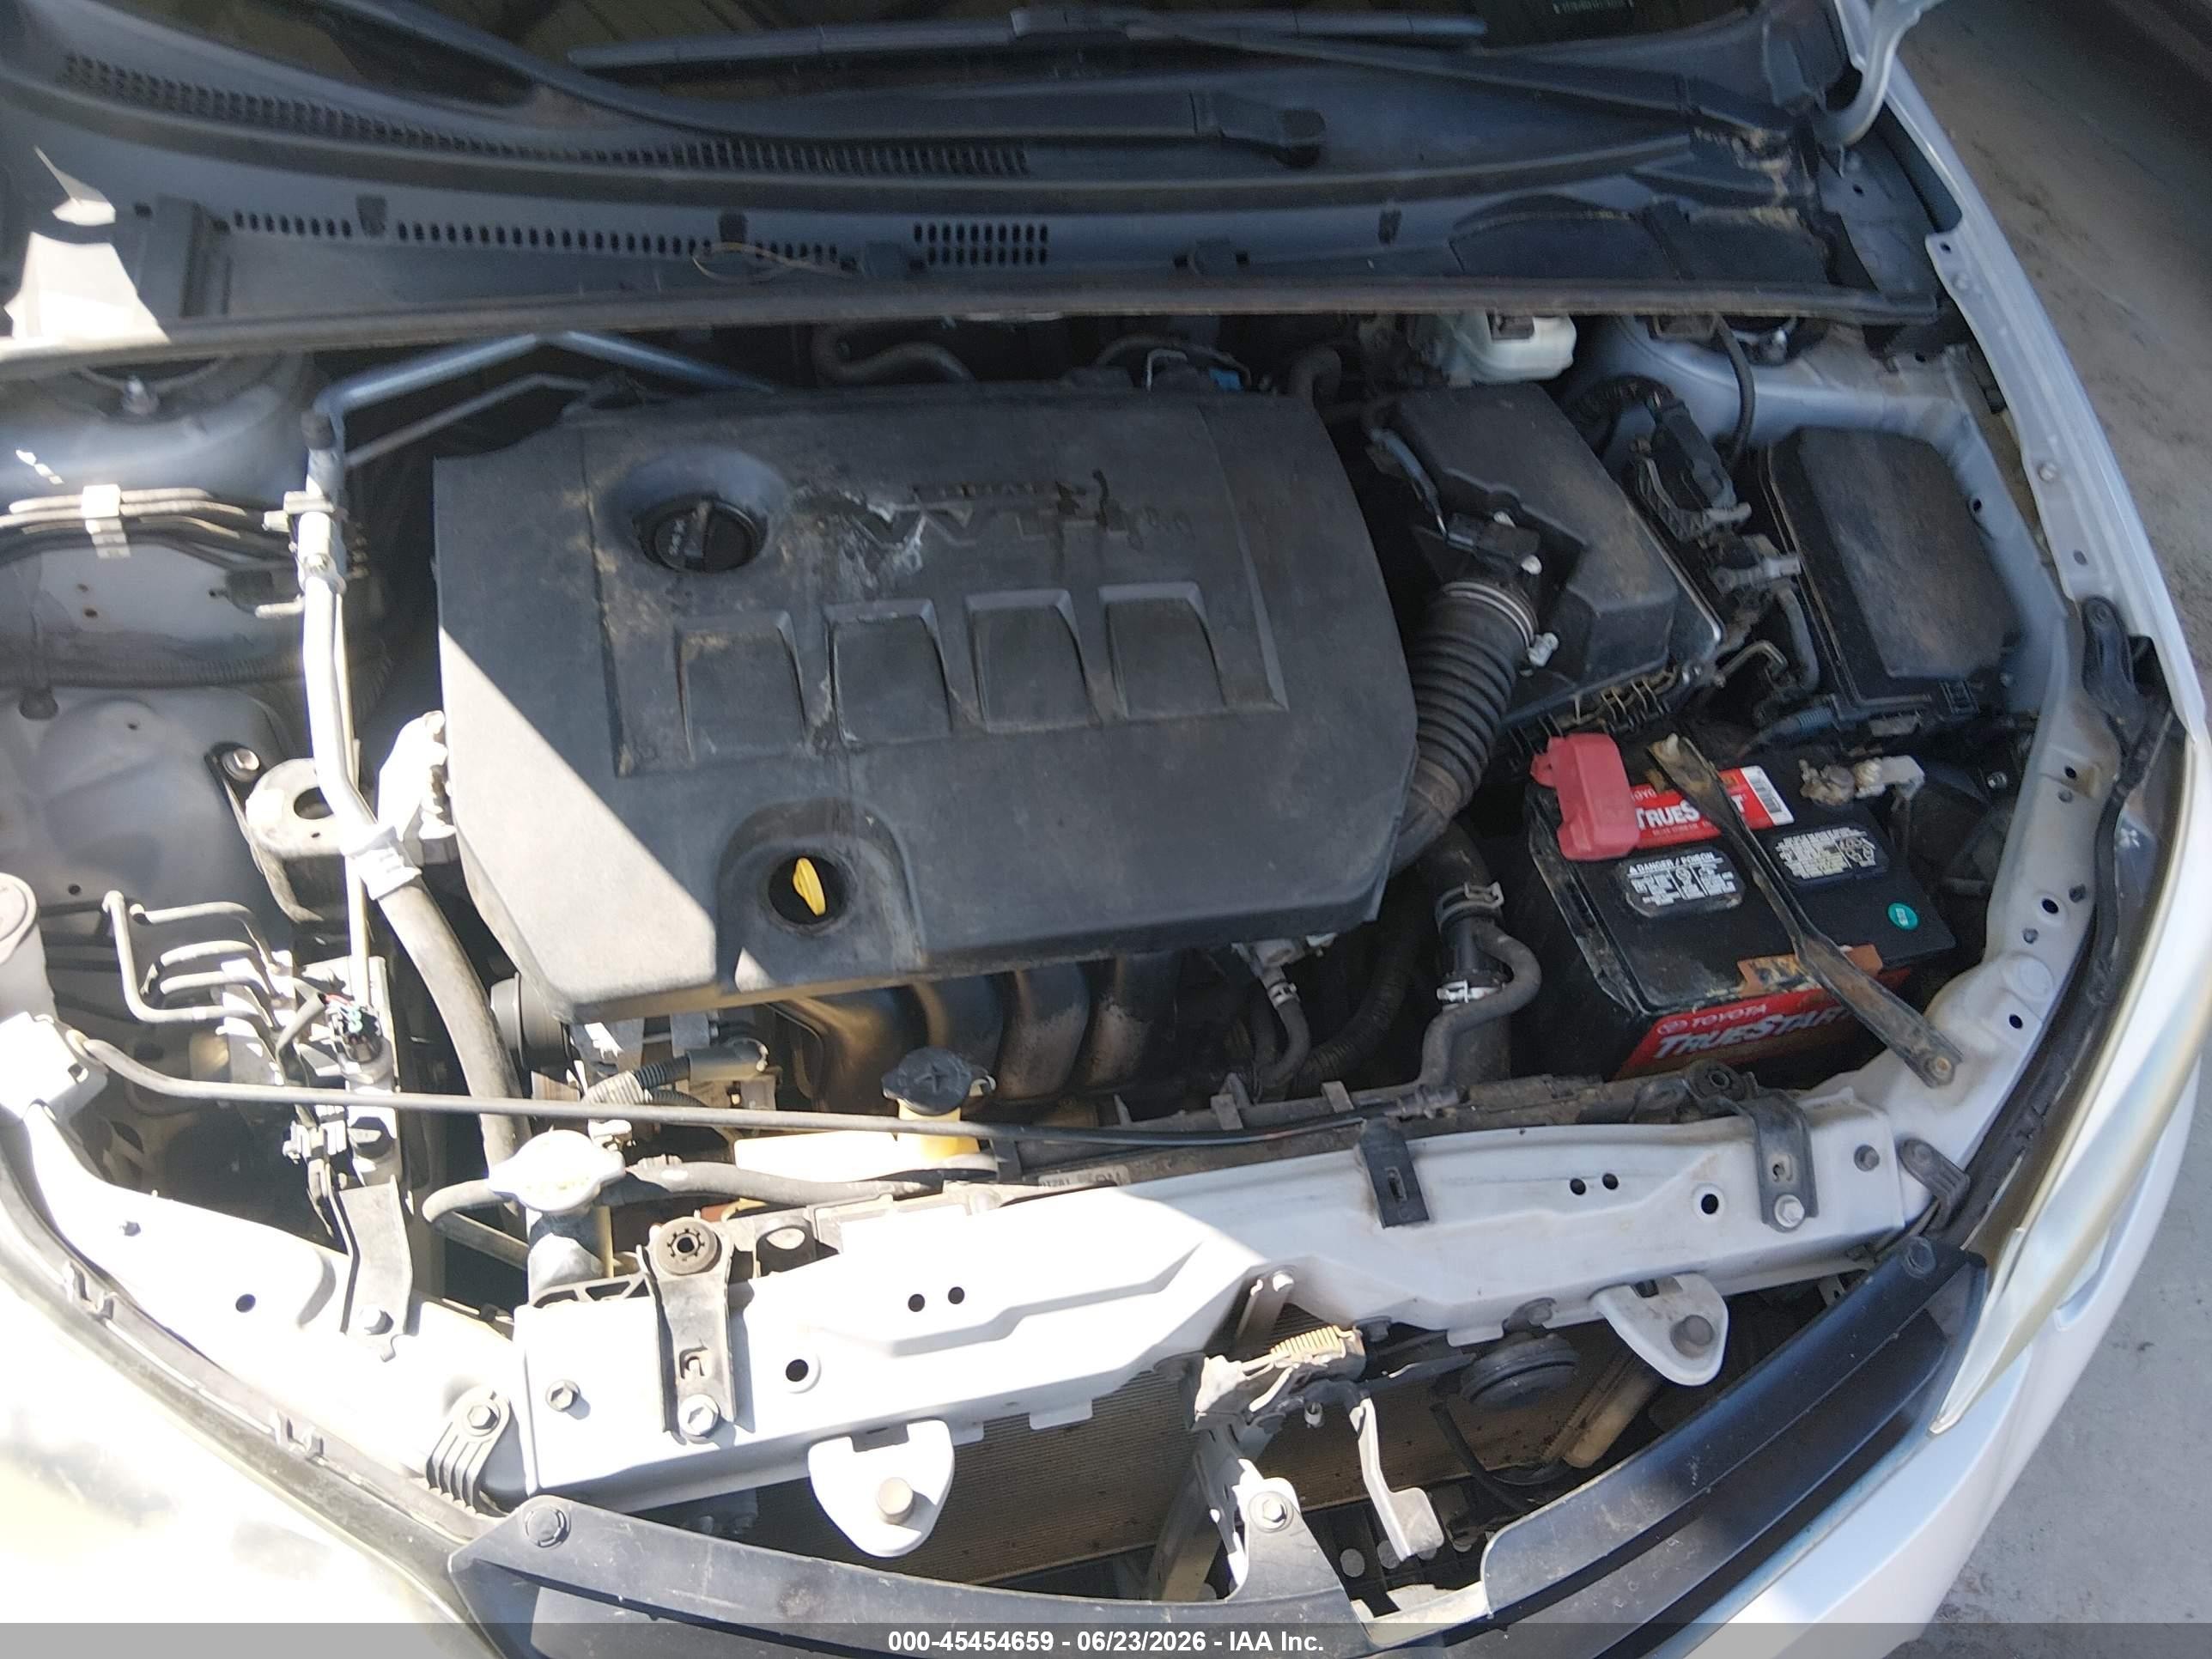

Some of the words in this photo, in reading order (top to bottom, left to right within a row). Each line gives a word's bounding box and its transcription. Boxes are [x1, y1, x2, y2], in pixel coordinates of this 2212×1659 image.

[1636, 859, 1674, 874] DANGER
[1680, 851, 1716, 865] POISON
[1692, 1004, 1767, 1028] TOYOTA
